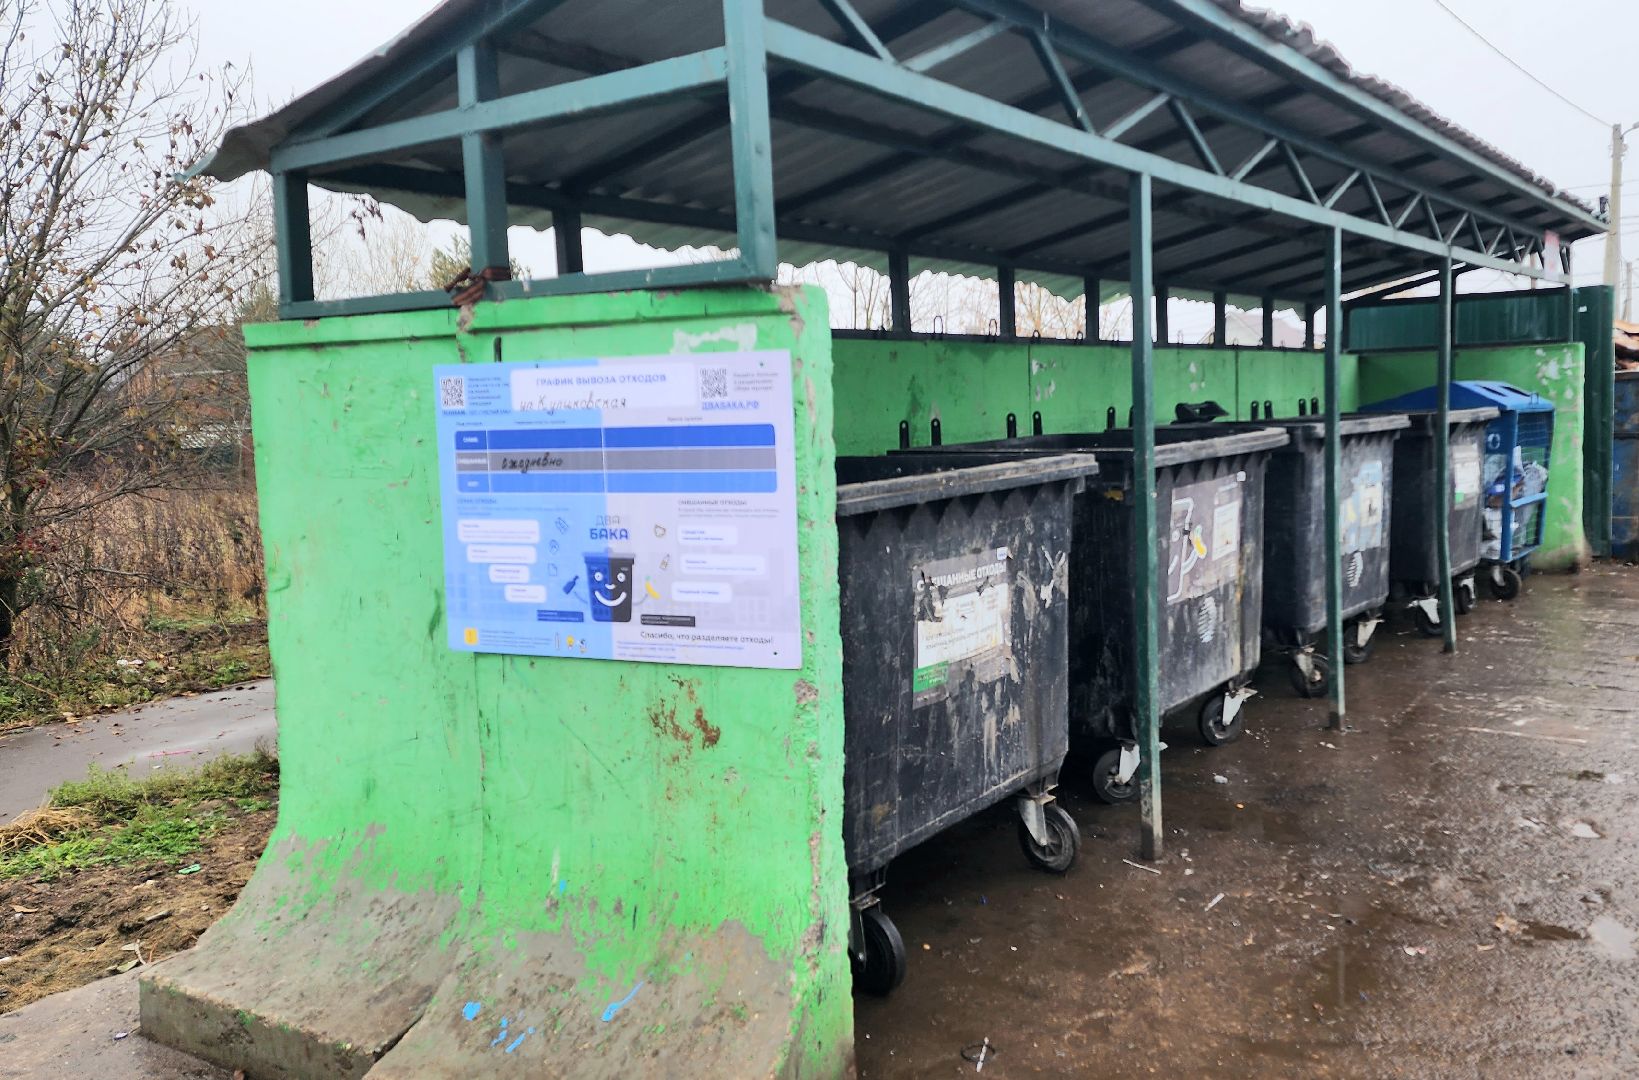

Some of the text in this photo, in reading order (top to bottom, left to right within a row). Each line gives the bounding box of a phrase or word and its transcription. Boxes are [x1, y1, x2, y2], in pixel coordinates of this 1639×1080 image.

[536, 374, 667, 387] ГРАФИК ВЫВОЗА ОТХОДОВ
[702, 400, 760, 411] ДВАБАКА.РФ
[501, 452, 563, 474] ежедневно
[596, 515, 621, 527] ДВА
[590, 528, 629, 541] БАКА
[976, 561, 1007, 579] ОТХОДЫ
[640, 631, 675, 641] Спасибо,
[691, 635, 739, 644] разделяете
[740, 636, 774, 645] отходы!
